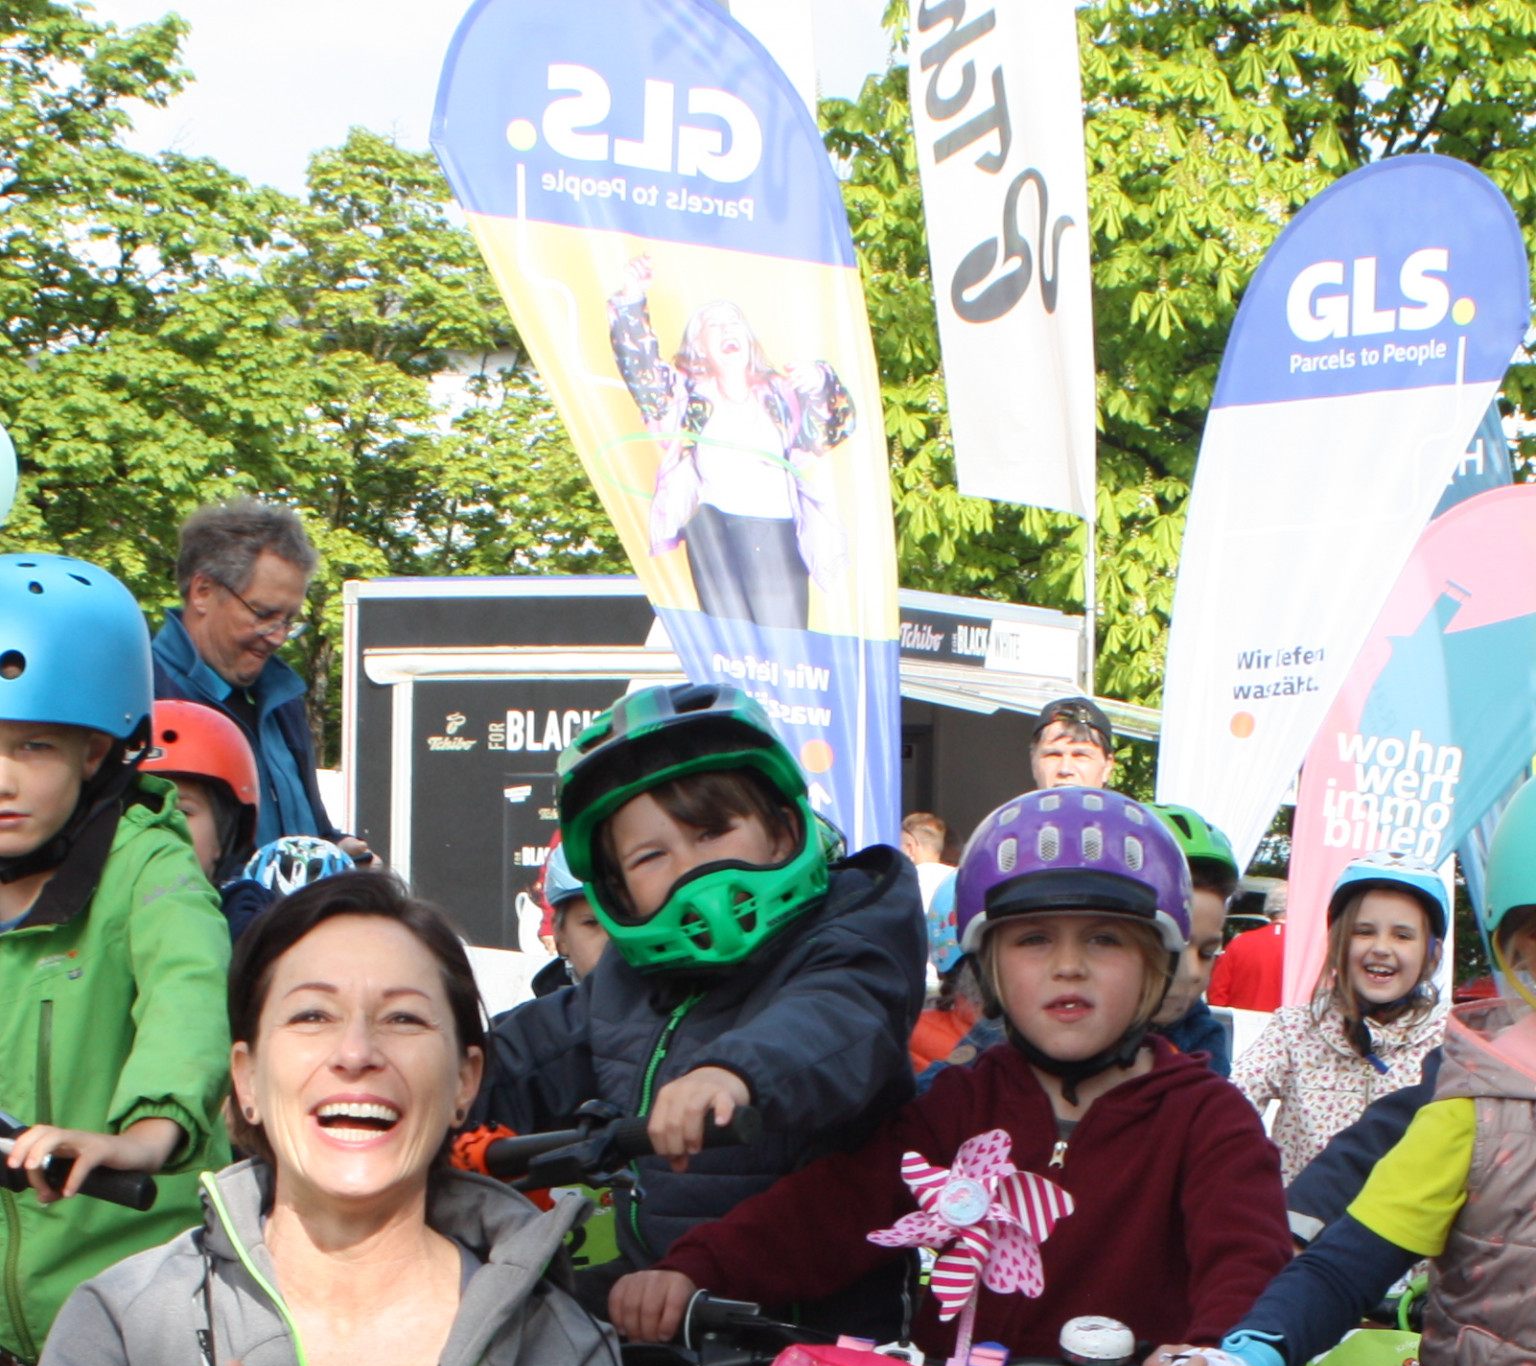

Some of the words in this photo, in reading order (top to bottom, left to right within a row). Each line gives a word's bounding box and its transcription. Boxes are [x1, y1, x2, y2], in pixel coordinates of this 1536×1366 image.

[1289, 349, 1356, 374] Parcels
[1361, 347, 1380, 366] to
[1383, 338, 1447, 366] People
[899, 622, 944, 652] Tchibo
[1237, 648, 1273, 670] Wir
[427, 736, 478, 752] Tchibo
[488, 722, 505, 750] FOR
[1337, 729, 1463, 777] wohn
[1355, 763, 1460, 804] wert
[1323, 778, 1451, 832] immo
[1323, 805, 1442, 858] bilien
[521, 846, 551, 867] BLA
